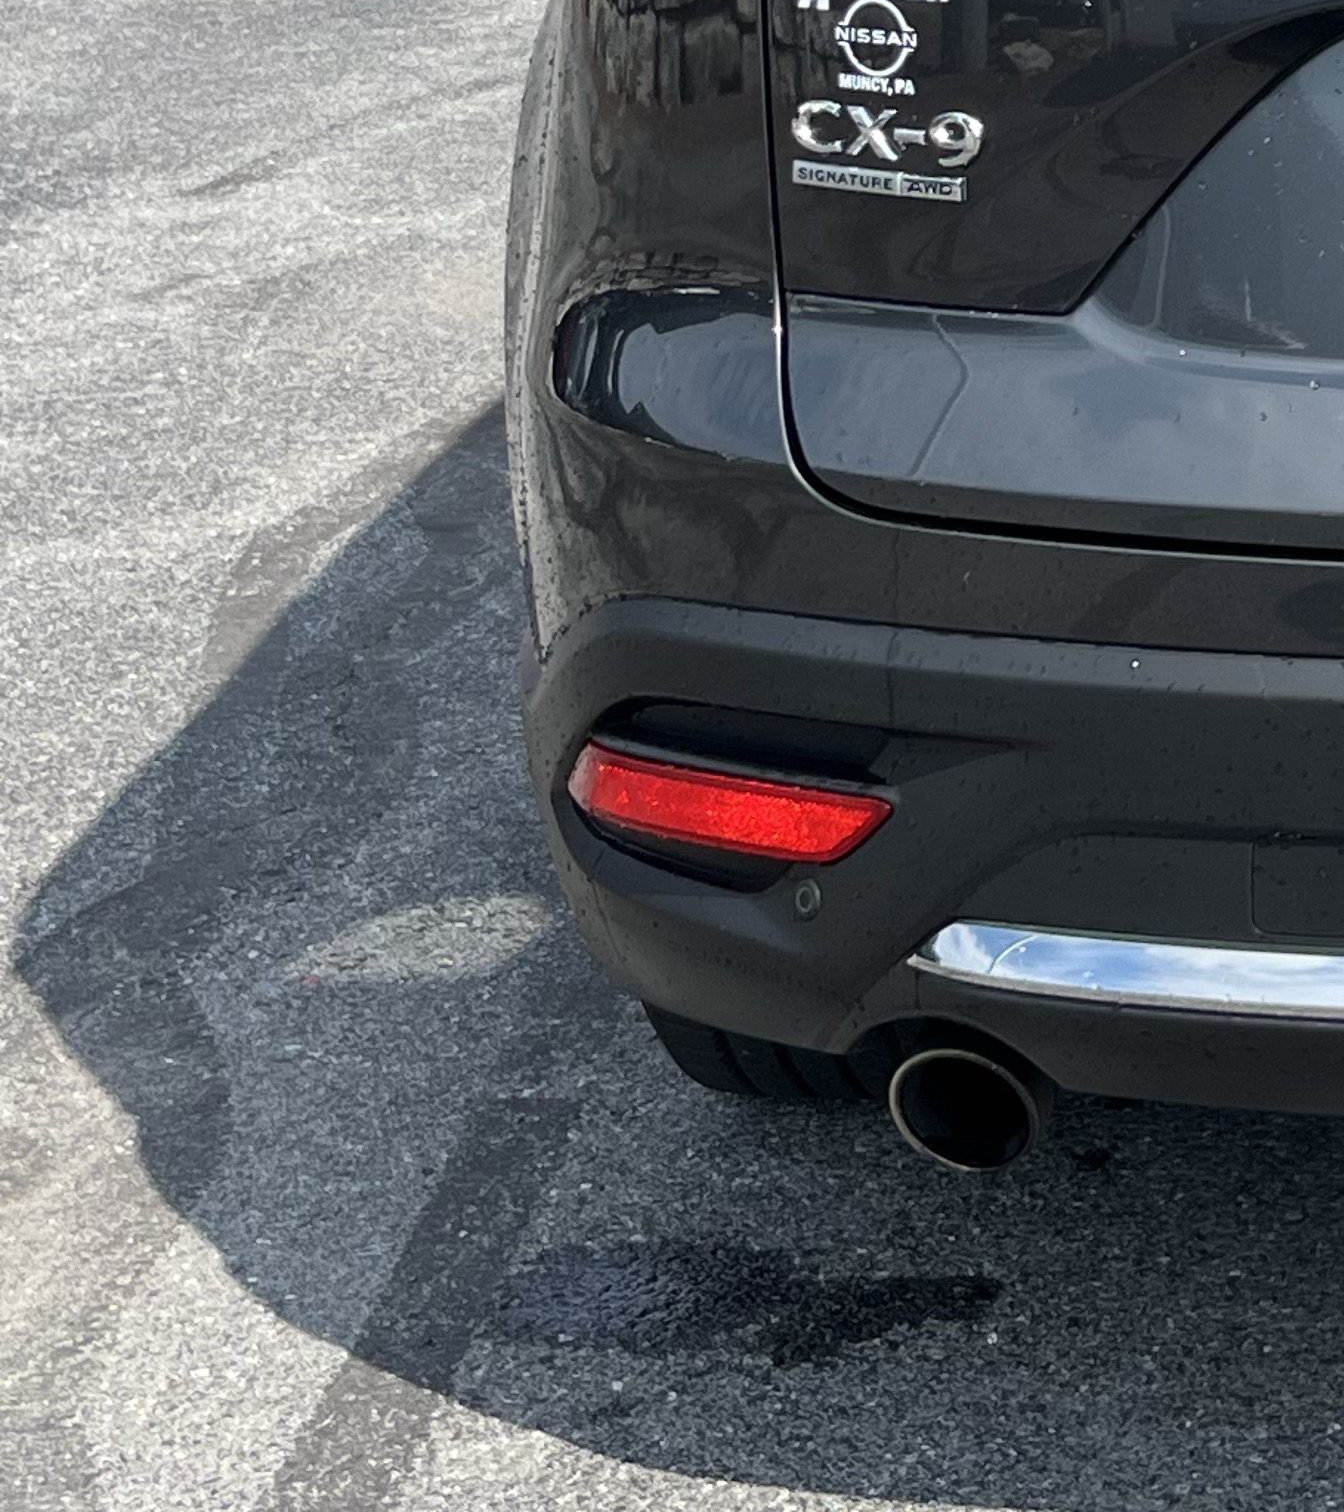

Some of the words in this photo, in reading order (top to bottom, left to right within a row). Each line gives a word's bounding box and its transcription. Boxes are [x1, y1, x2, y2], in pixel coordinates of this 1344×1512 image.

[834, 25, 918, 48] NISSAN
[791, 99, 985, 169] CX-9
[797, 166, 894, 191] SIGNATURE
[906, 179, 953, 197] AWD
